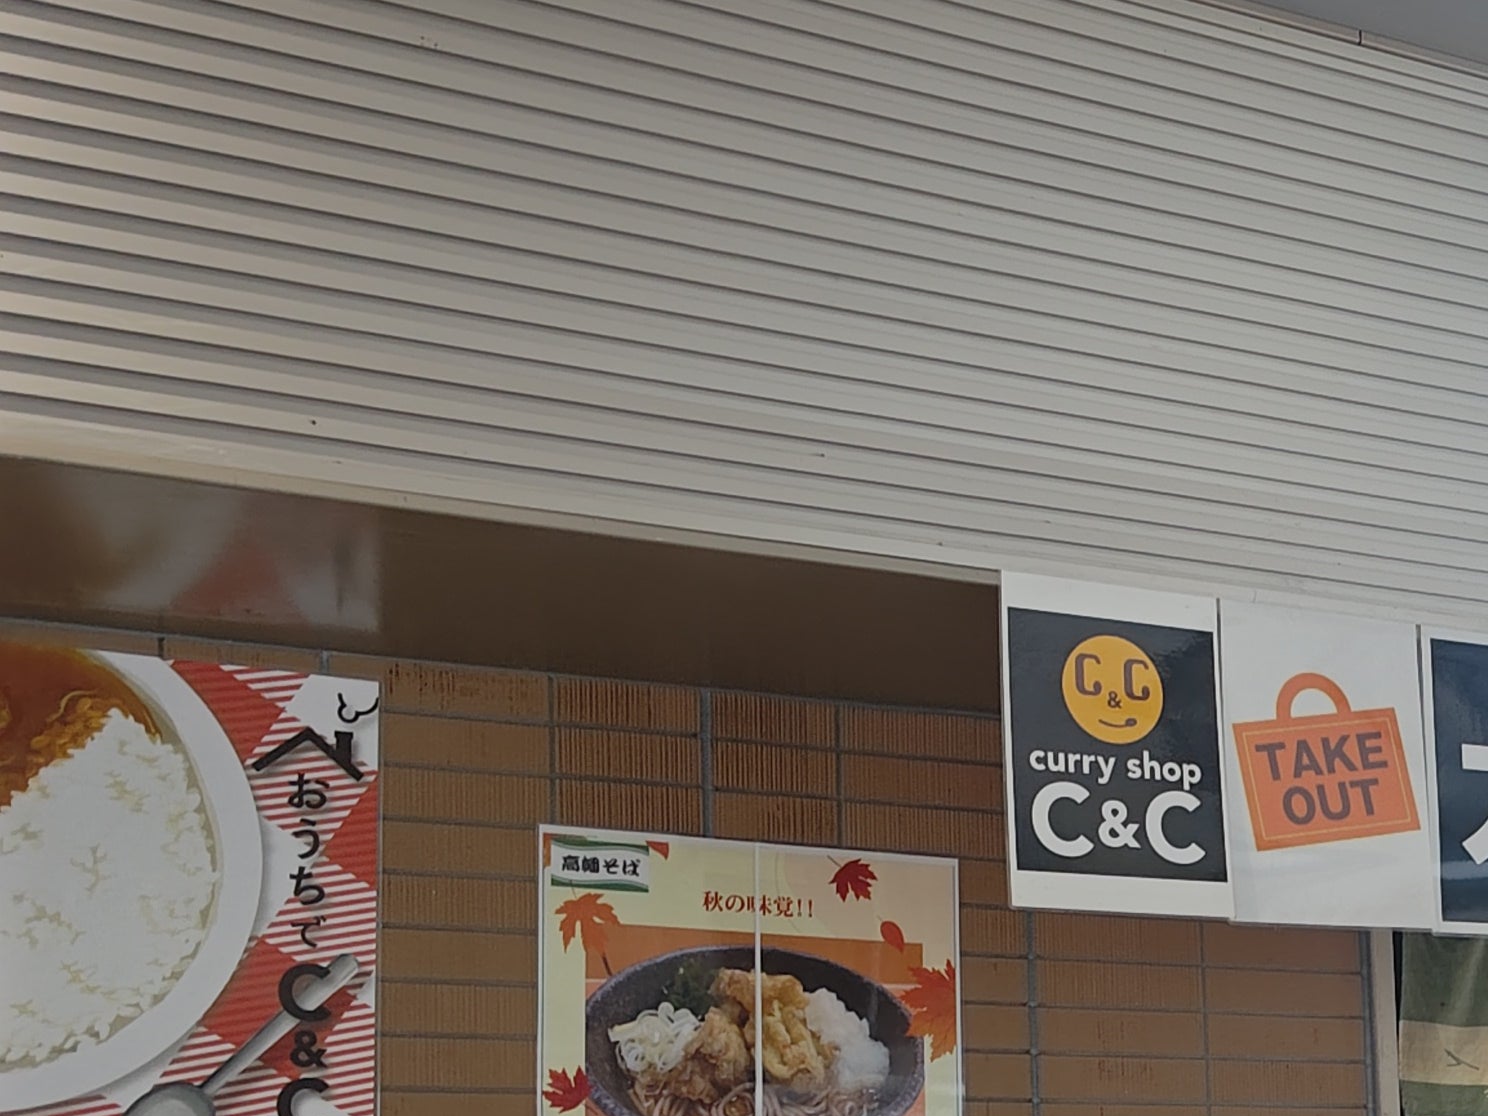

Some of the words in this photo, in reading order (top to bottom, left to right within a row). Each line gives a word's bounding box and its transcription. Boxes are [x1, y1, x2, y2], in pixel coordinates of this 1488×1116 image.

[1029, 749, 1115, 785] curry
[1126, 750, 1202, 790] shop
[1255, 731, 1389, 782] TAKE
[1031, 781, 1206, 865] C&C
[1282, 778, 1380, 826] OUT
[562, 854, 641, 877] 高幡そば
